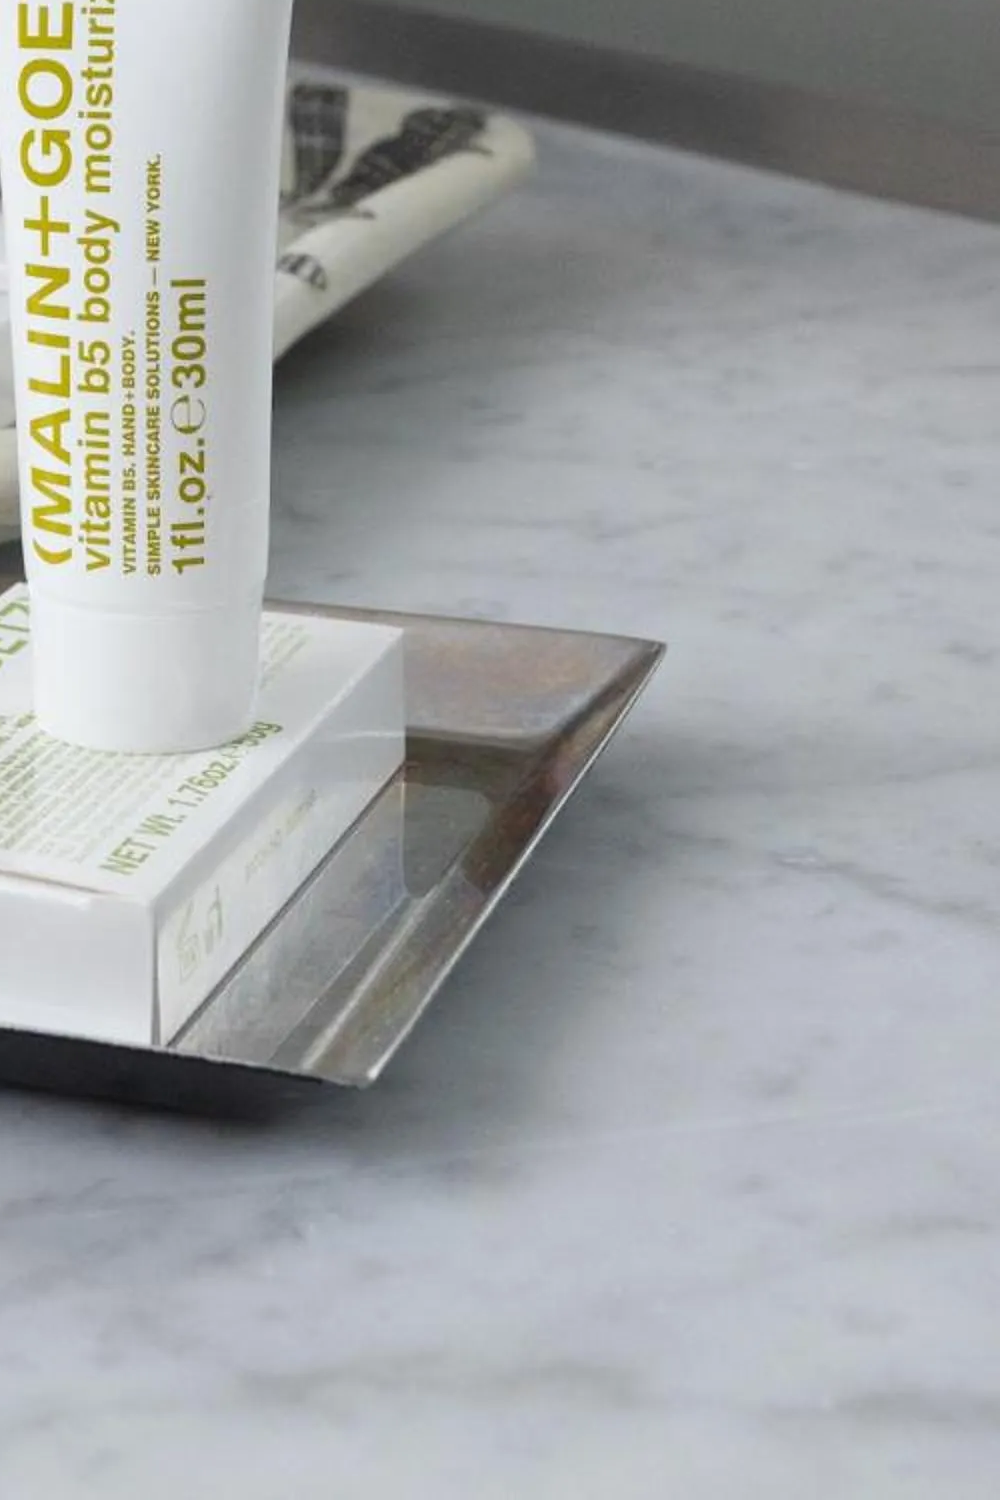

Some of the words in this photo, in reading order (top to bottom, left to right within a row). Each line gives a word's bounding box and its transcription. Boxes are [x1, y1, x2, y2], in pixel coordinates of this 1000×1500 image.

[146, 153, 161, 213] YORK.
[77, 208, 121, 324] body
[146, 217, 161, 261] NEW
[77, 340, 112, 394] b5
[146, 291, 161, 400] SOLUTIONS
[121, 330, 136, 457] HAND+BODY.
[77, 409, 111, 572] vitamin
[121, 462, 137, 492] B5.
[146, 405, 161, 500] SKINCARE
[121, 497, 137, 574] VITAMIN
[146, 502, 161, 577] SIMPLE
[98, 837, 157, 875] NET
